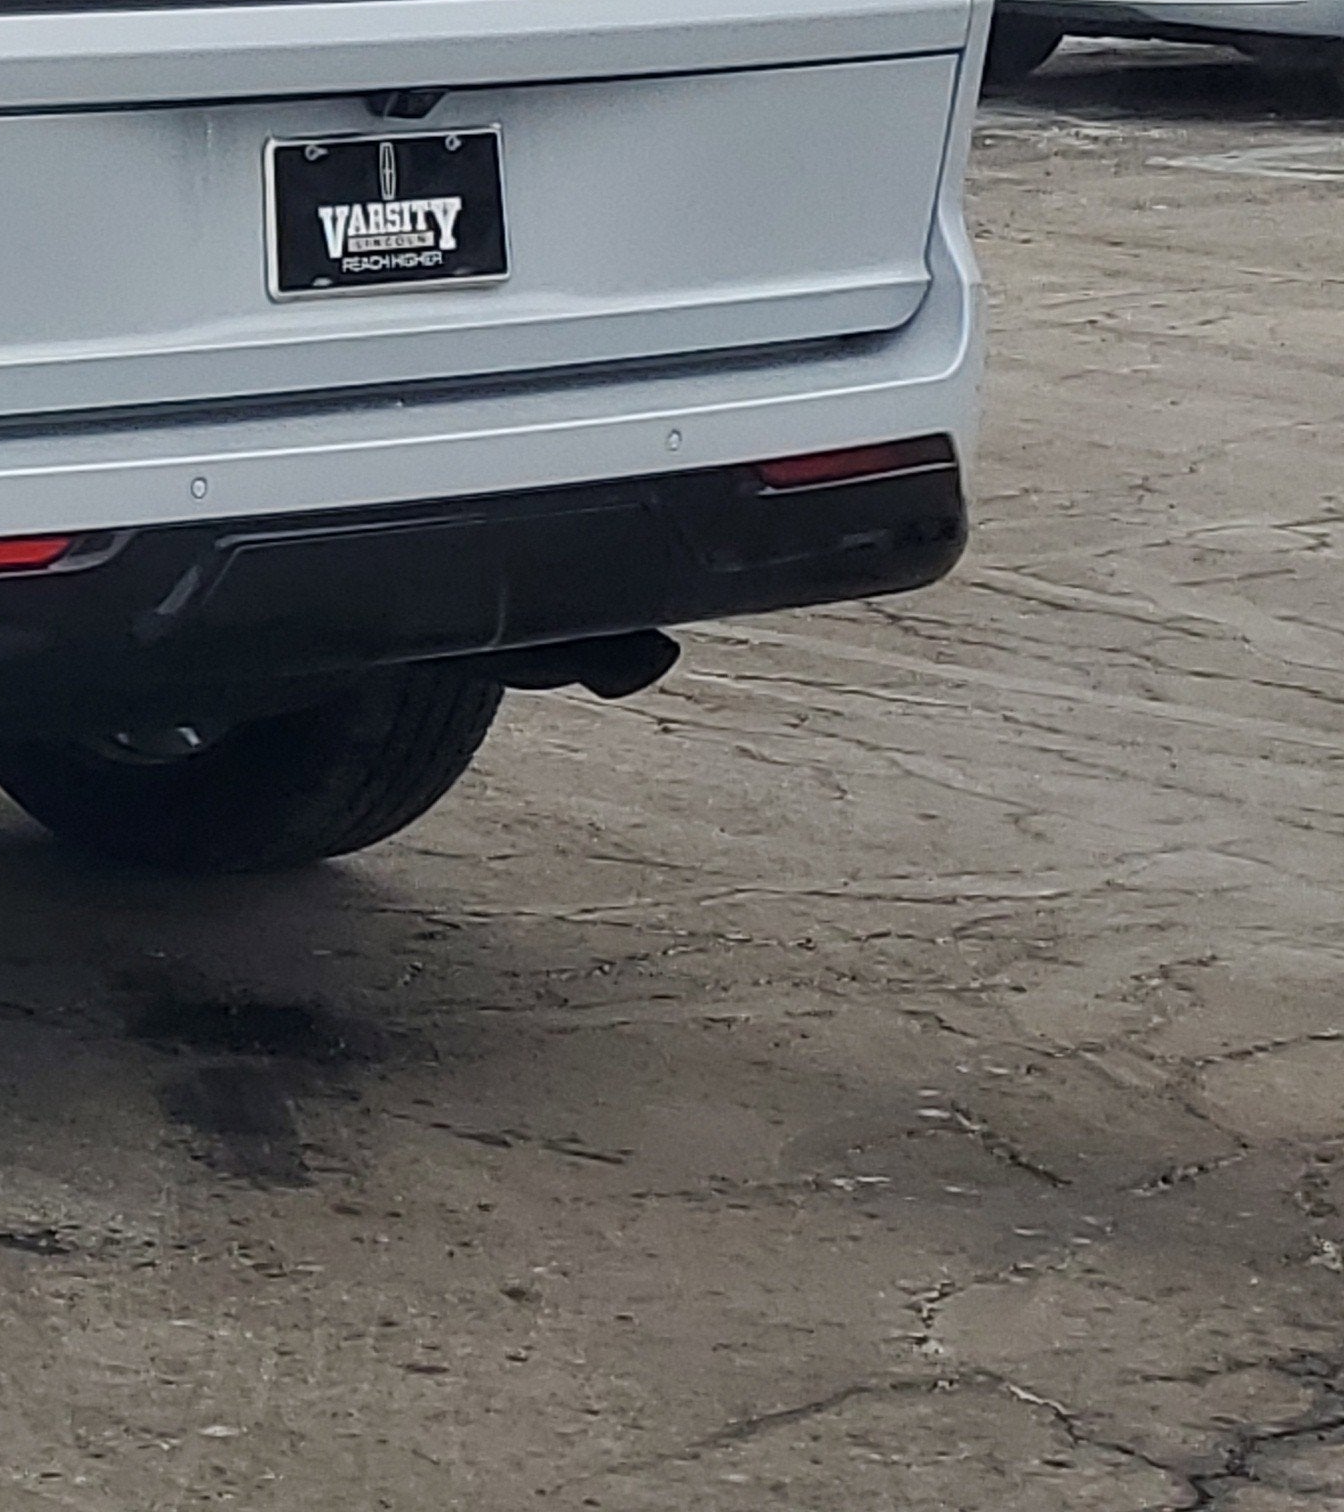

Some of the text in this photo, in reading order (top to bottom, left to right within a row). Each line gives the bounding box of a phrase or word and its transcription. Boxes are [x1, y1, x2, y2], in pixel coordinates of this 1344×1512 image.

[318, 197, 461, 258] VARSITY
[355, 235, 427, 249] LINCOLN
[342, 254, 391, 273] REACH
